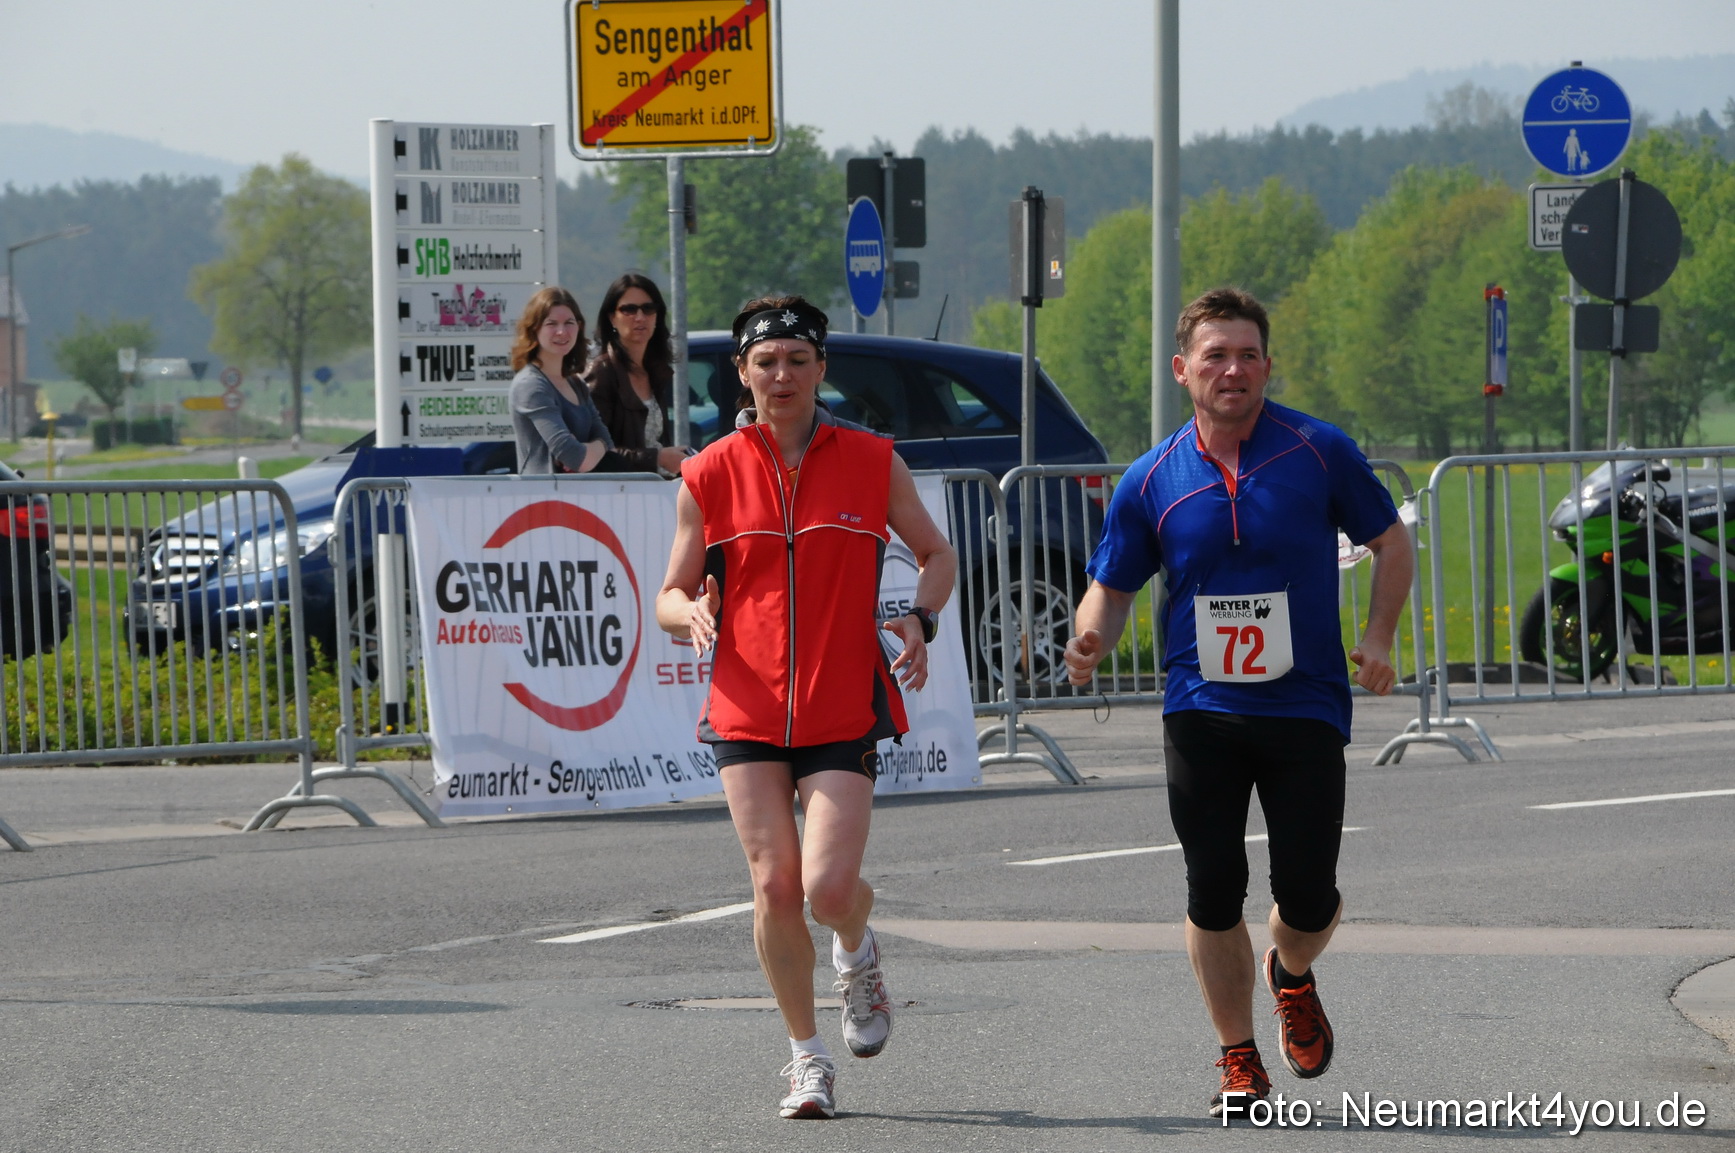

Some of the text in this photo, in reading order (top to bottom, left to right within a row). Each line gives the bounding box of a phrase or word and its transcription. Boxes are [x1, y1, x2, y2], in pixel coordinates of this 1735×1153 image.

[596, 16, 752, 63] Sengenthal
[617, 65, 732, 91] am Anger
[593, 105, 760, 128] Kreis Neumarkt i.d.OPf.
[451, 128, 519, 151] HOLZAMMER
[452, 181, 520, 204] HOLZAMMER
[415, 238, 450, 278] SHB
[416, 345, 475, 382] THULE
[436, 560, 617, 614] GERHART &
[877, 599, 911, 619] ISS
[1210, 600, 1251, 611] MEYER
[1210, 611, 1252, 619] WERBUNG
[437, 614, 623, 669] Autohaus JÄNIG
[1216, 625, 1267, 675] 72
[548, 756, 646, 800] Sengenthal
[652, 753, 692, 784] Tel.
